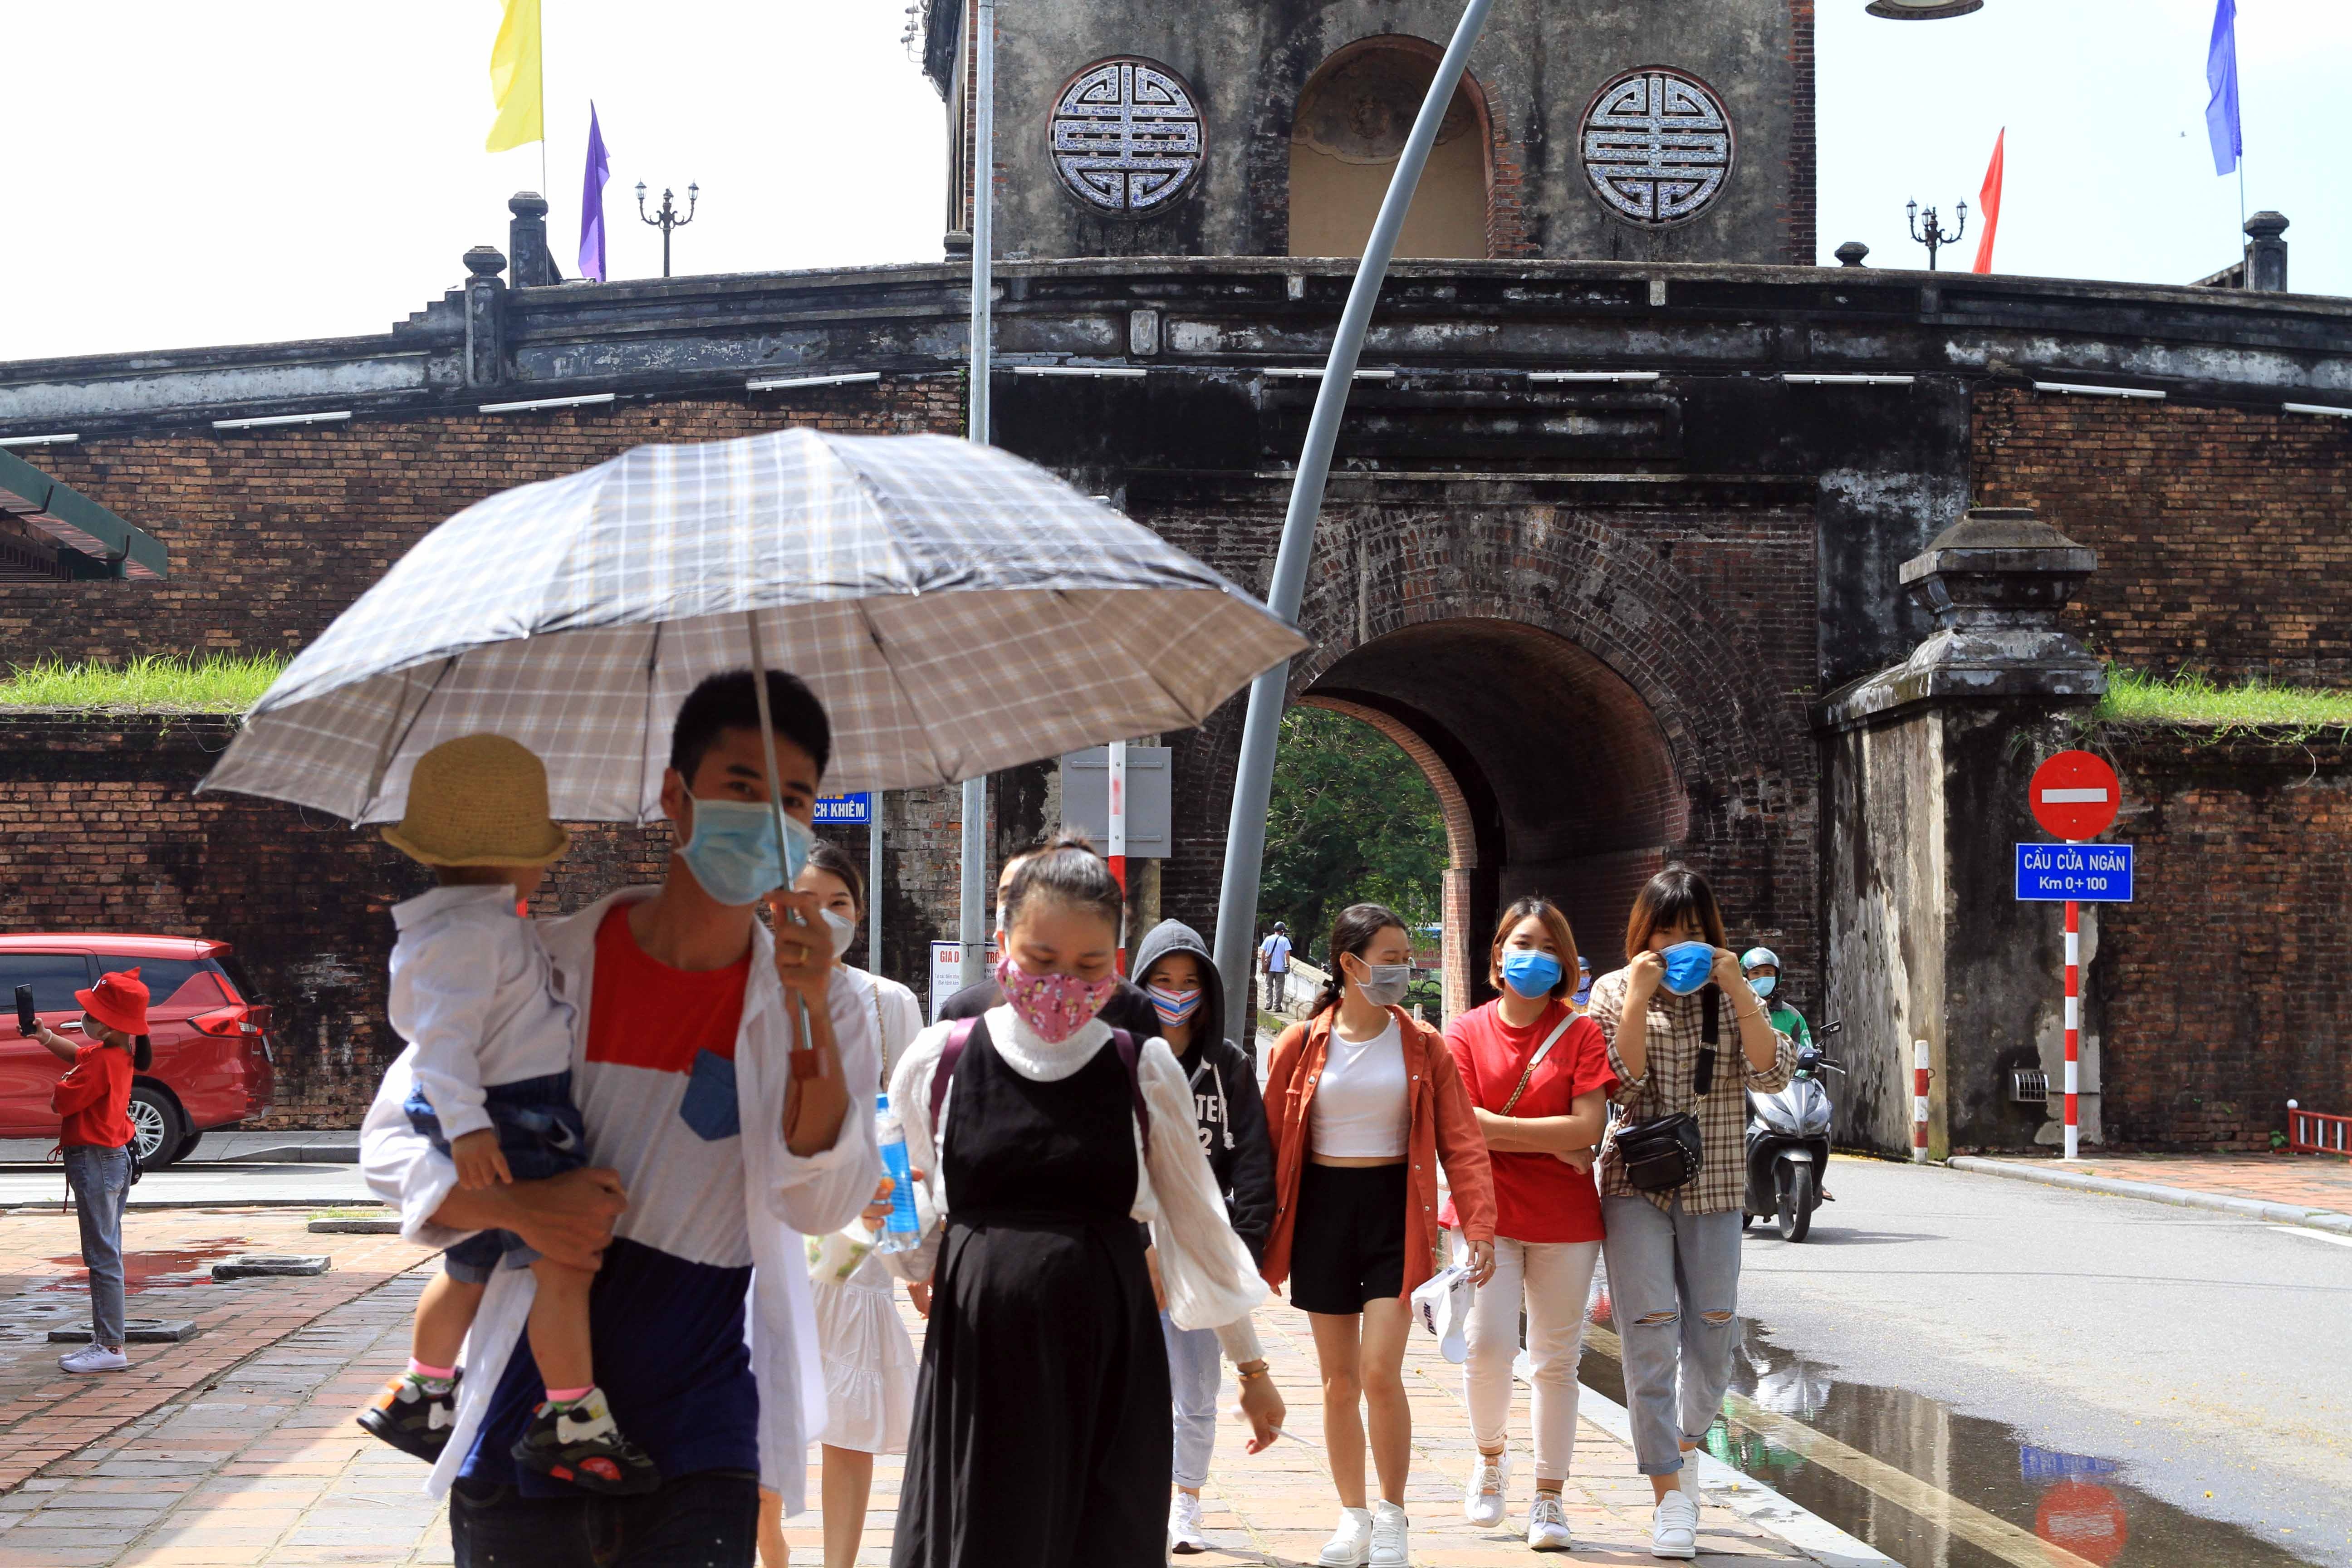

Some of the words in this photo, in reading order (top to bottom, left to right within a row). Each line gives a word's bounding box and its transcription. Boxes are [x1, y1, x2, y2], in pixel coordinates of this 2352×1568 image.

[813, 803, 827, 817] CH
[830, 800, 864, 817] KHIÊM
[2024, 847, 2051, 870] CẦU
[2057, 848, 2083, 871] CỬA
[2089, 850, 2125, 871] NGĂN
[2039, 876, 2062, 889] Km
[940, 948, 952, 963] GIÁ
[1198, 1127, 1213, 1155] 2
